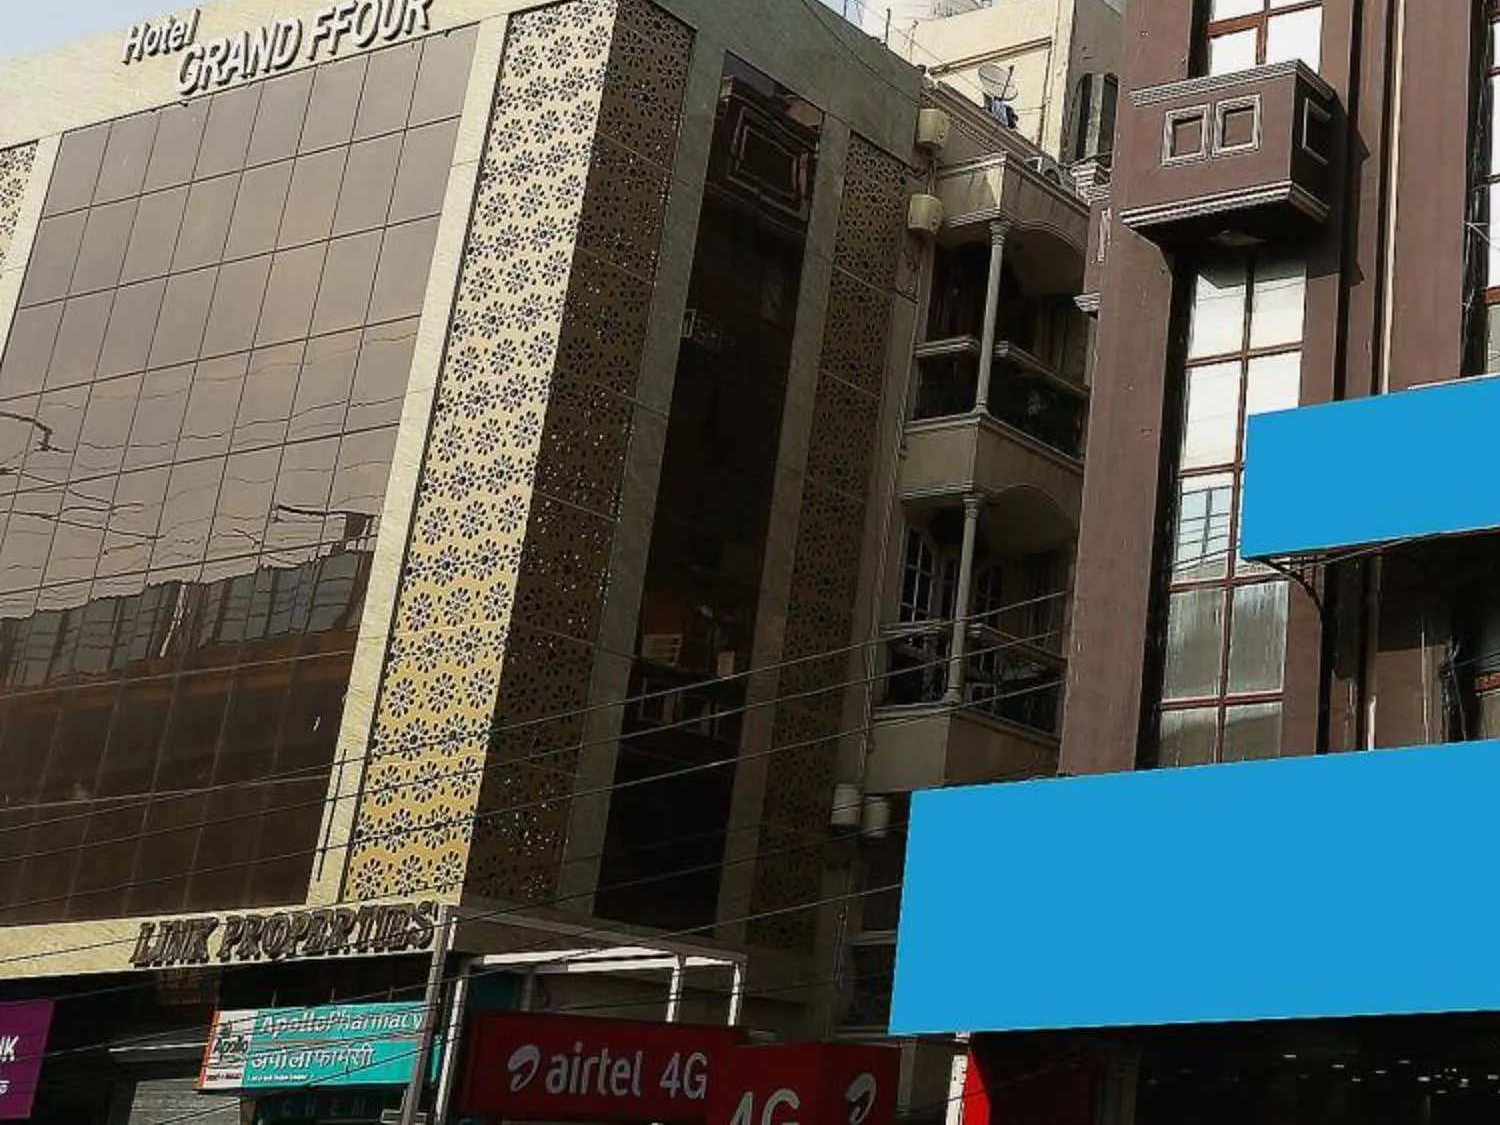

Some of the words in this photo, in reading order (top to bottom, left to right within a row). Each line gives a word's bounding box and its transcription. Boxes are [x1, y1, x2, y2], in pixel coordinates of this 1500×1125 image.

[121, 7, 201, 66] Hotel
[175, 17, 303, 95] GRAND
[129, 916, 219, 968] LINK
[217, 900, 439, 963] PROPERTIES
[545, 1041, 643, 1097] airtel
[659, 1051, 708, 1101] 4G
[729, 1087, 804, 1125] 4G
